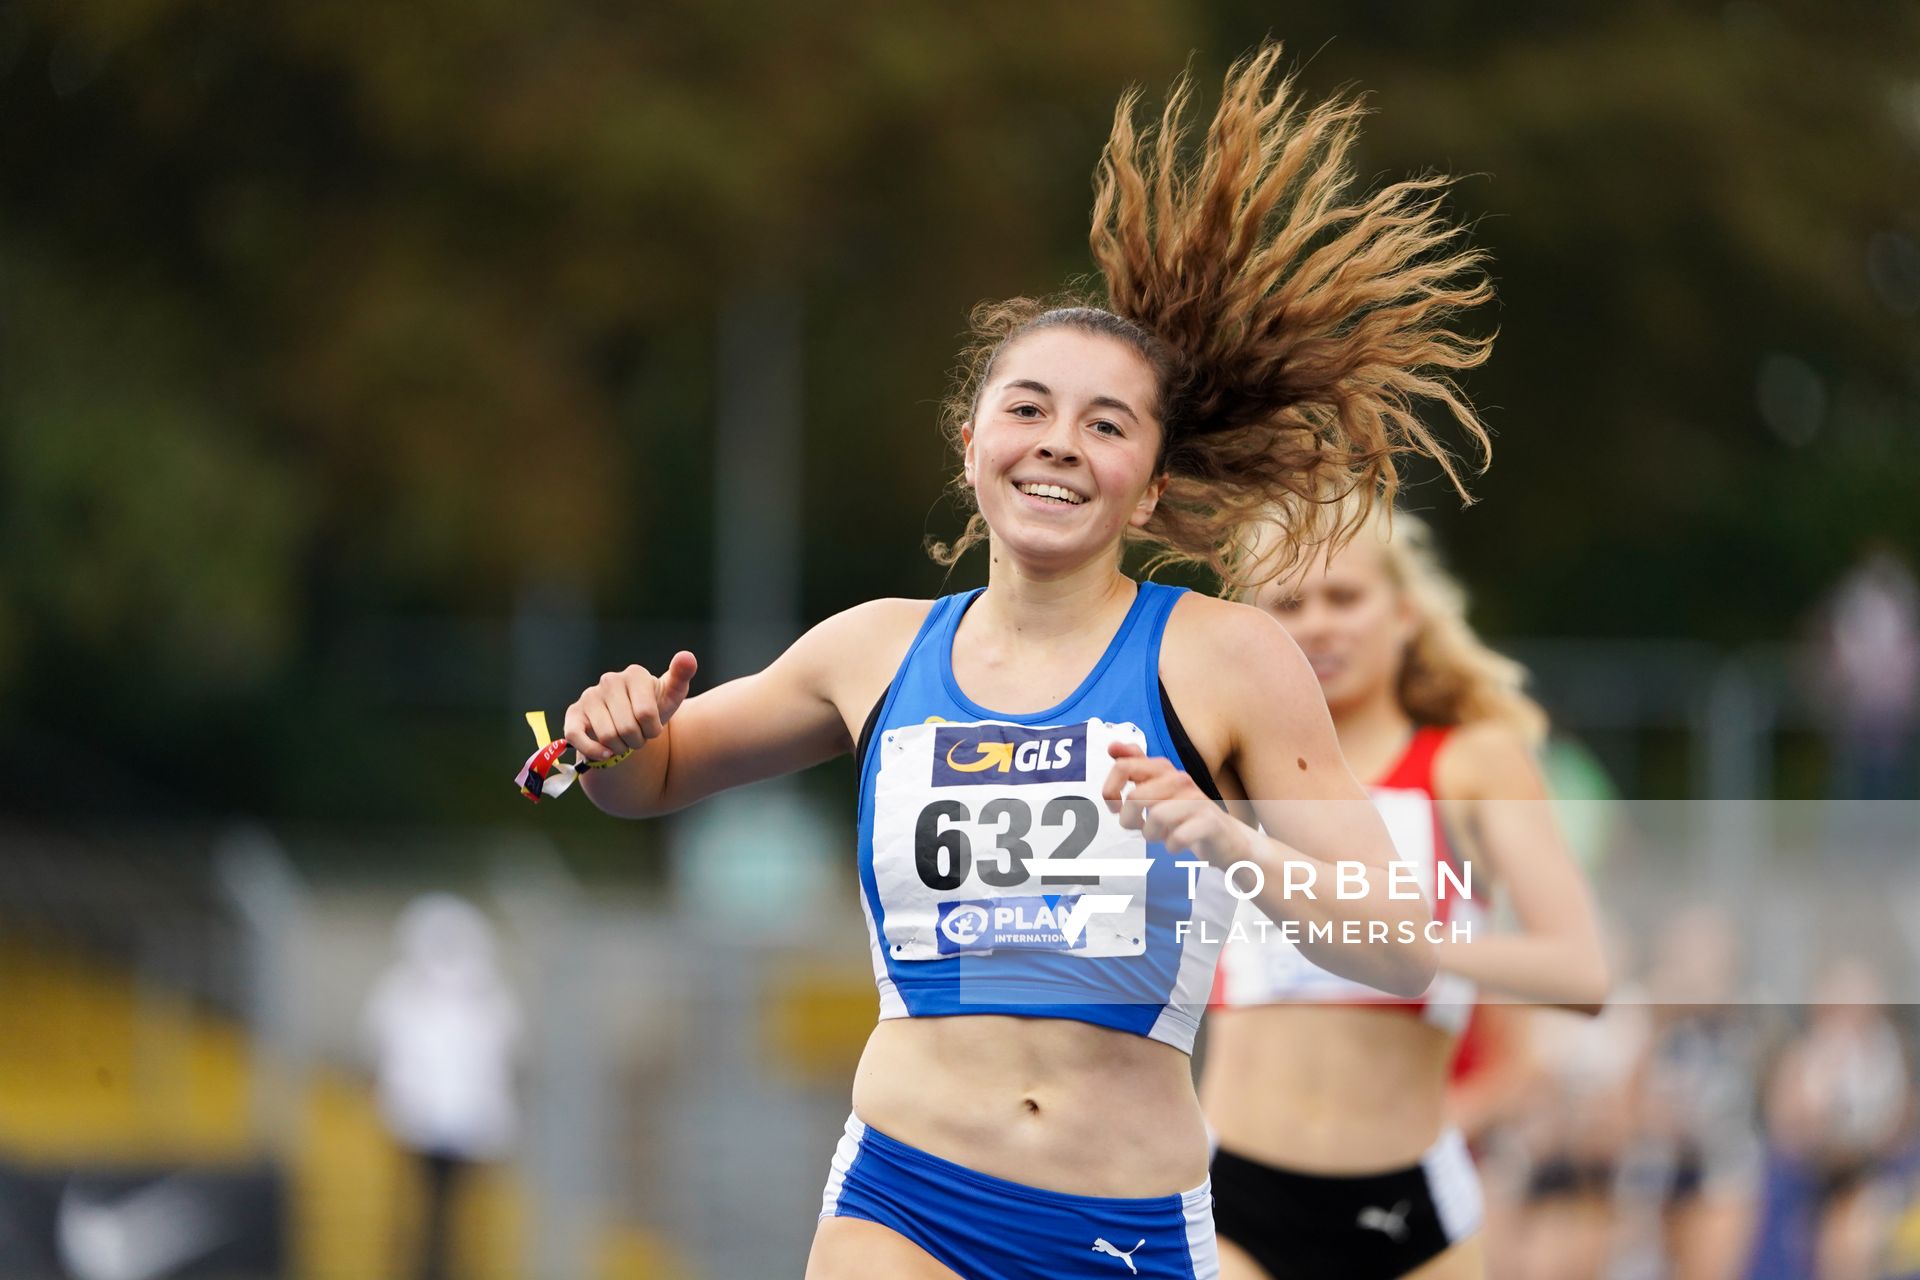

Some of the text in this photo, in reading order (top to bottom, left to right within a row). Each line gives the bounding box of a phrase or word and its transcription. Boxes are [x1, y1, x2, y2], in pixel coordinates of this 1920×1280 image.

[543, 738, 567, 761] DEU
[1014, 738, 1073, 772] GLS
[914, 795, 1100, 891] 632
[994, 933, 1079, 944] INTERNATION
